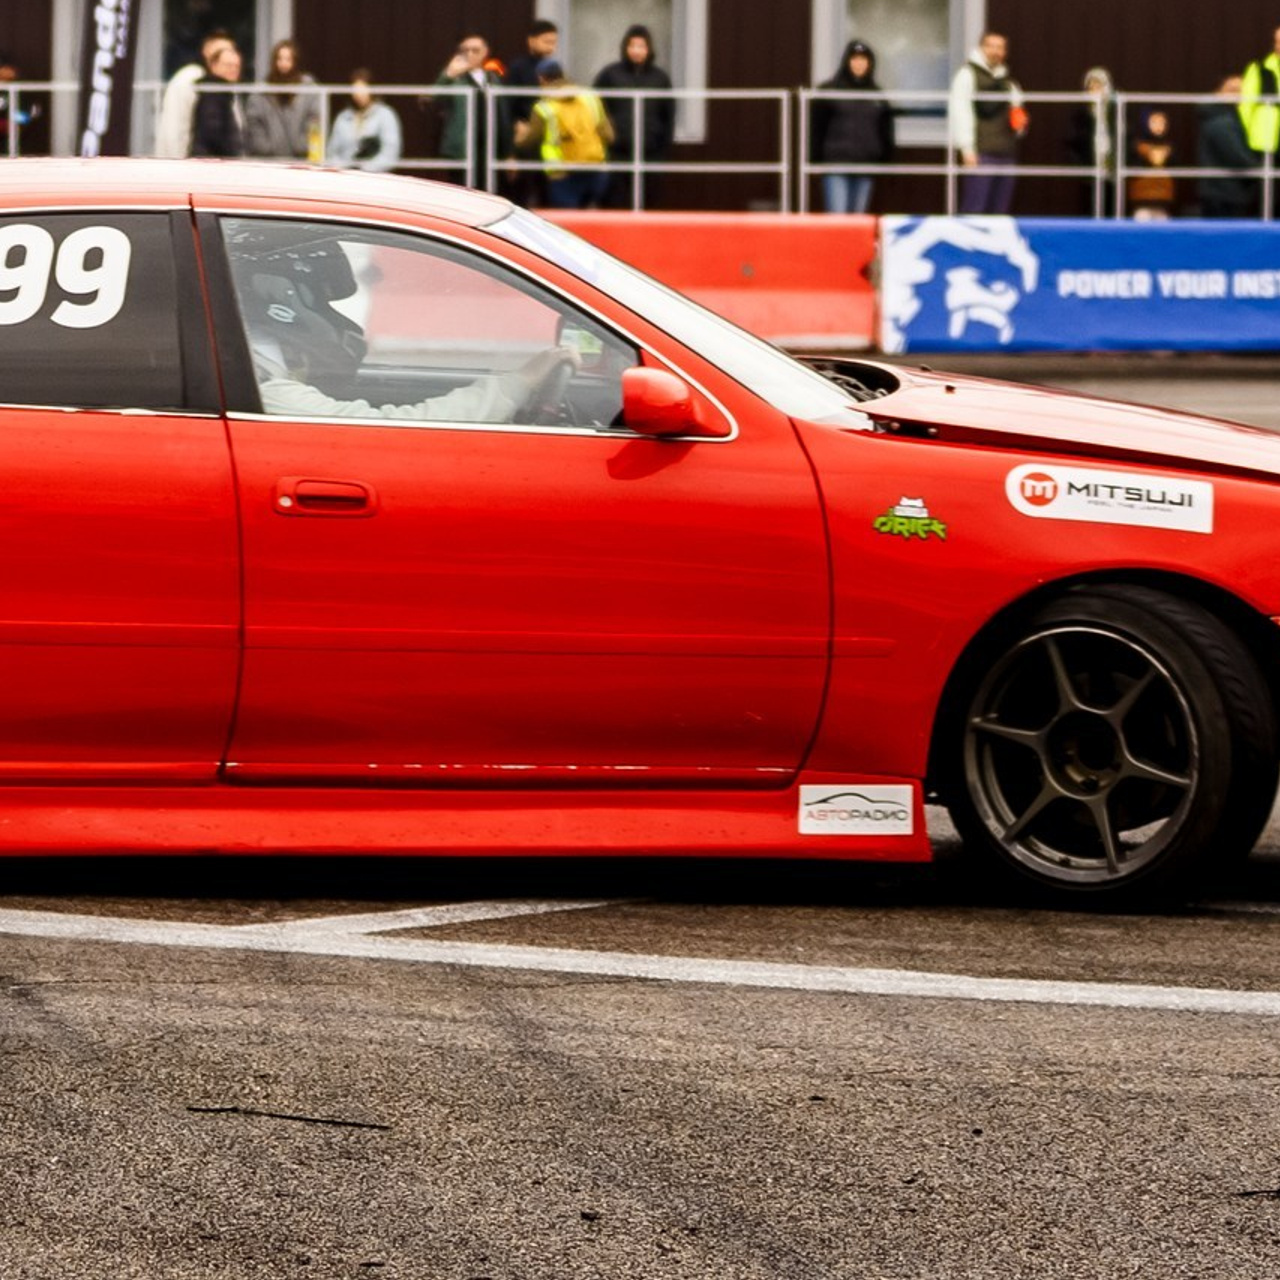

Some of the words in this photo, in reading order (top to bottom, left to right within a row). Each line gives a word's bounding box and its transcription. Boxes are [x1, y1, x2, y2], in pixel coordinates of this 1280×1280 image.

[1057, 270, 1152, 298] POWER
[1157, 270, 1227, 298] YOUR
[1067, 481, 1193, 507] MITSUJI
